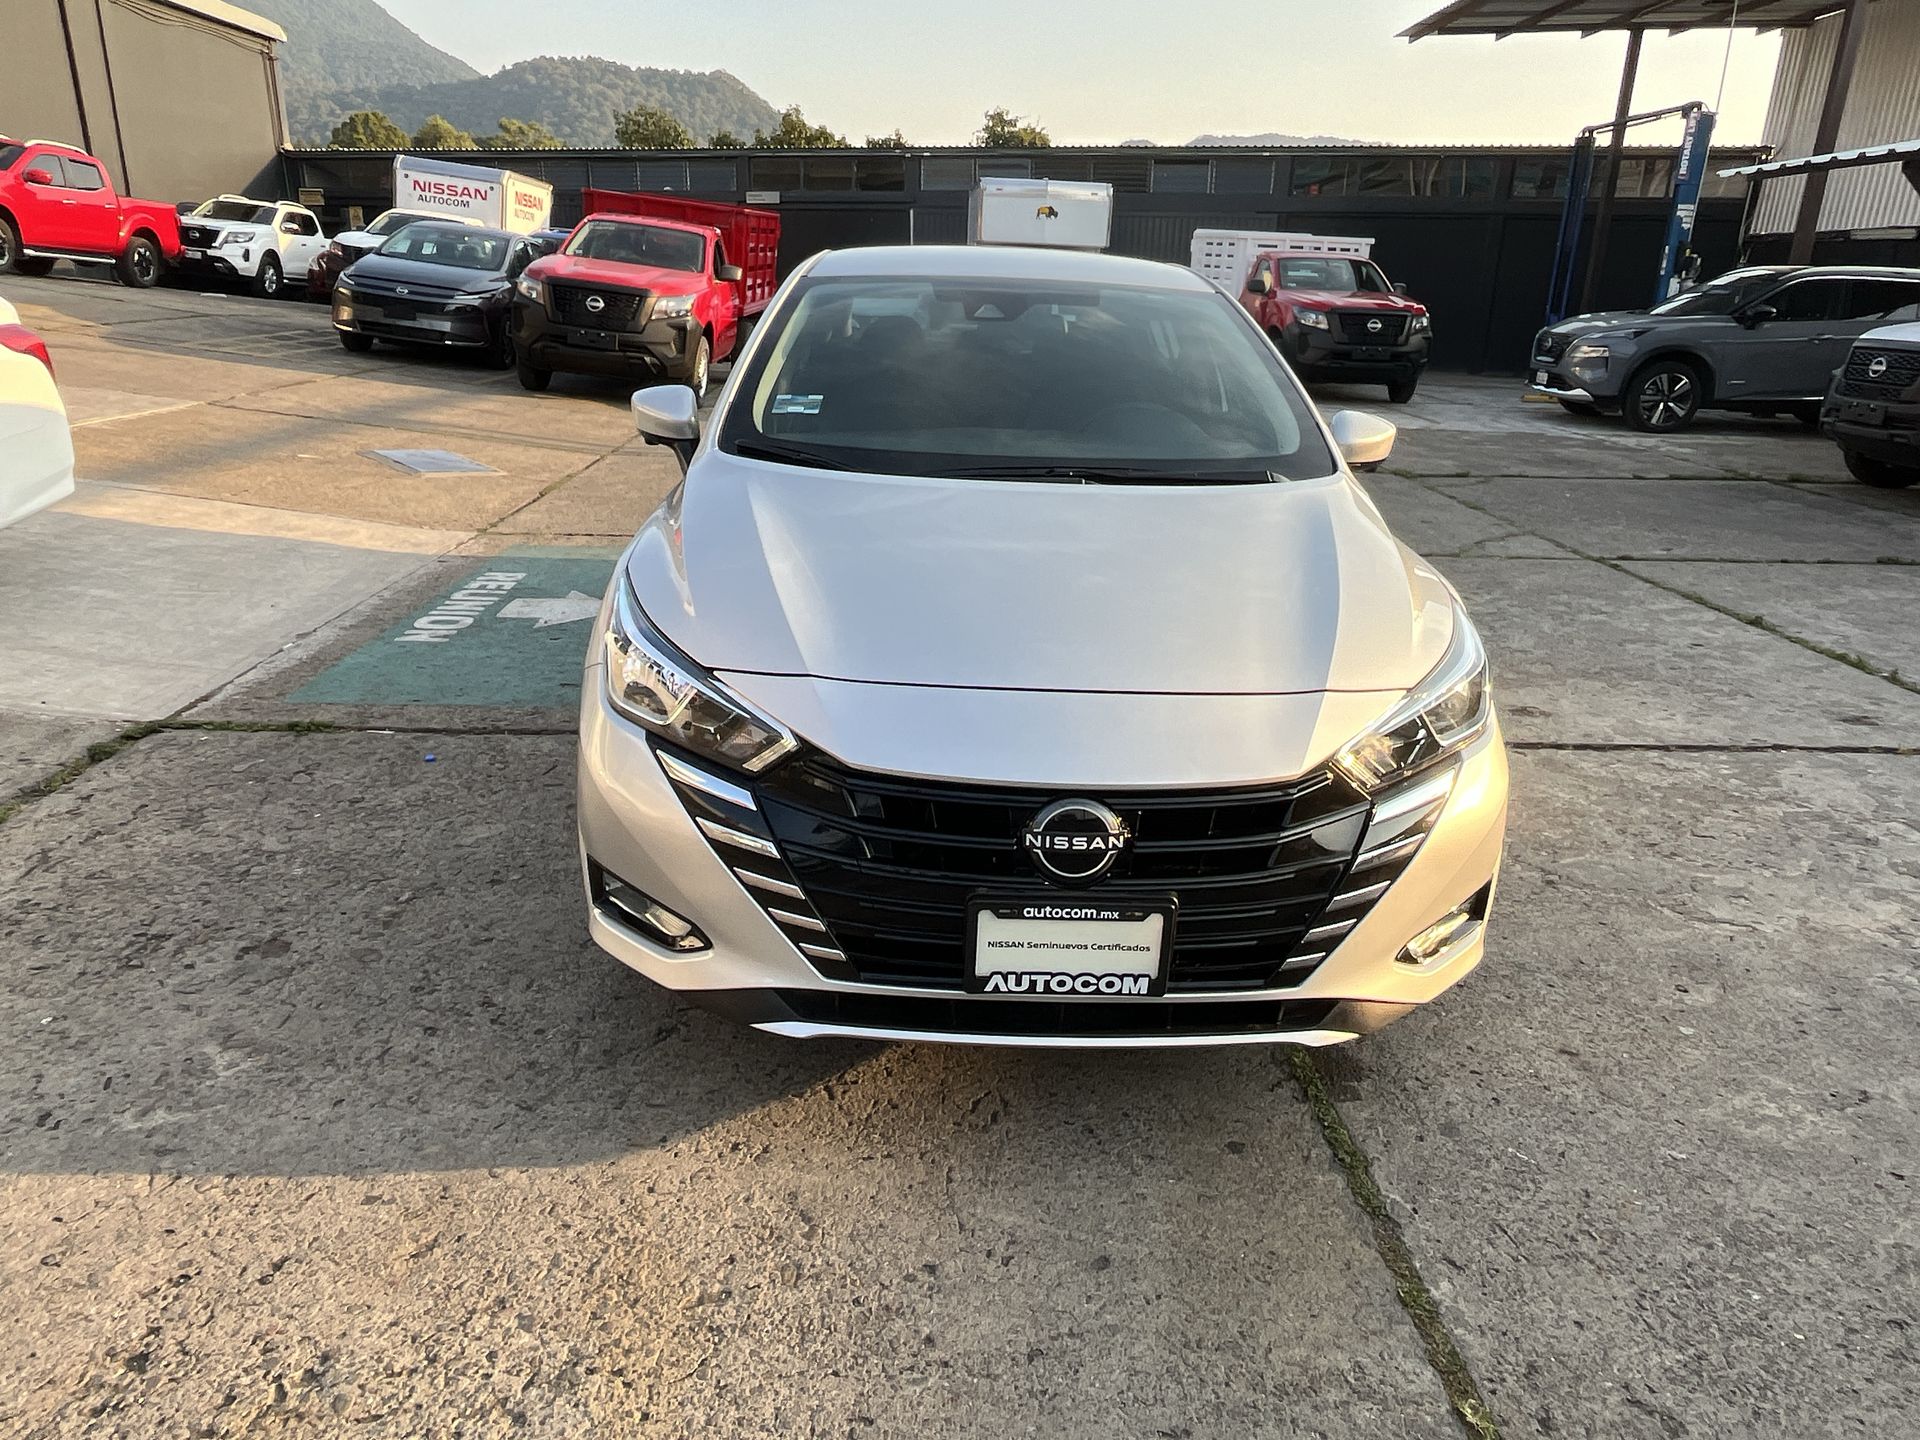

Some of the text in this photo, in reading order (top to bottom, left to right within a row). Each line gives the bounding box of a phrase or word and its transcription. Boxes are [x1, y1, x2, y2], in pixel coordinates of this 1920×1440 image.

[413, 179, 488, 201] NISSAN
[417, 194, 470, 209] AUTOCOM
[515, 190, 543, 211] NISSAN
[1025, 834, 1124, 850] NISSAN
[1023, 906, 1120, 920] autocom.mx
[987, 941, 1151, 952] NISSAN Seminuevos Certificados
[984, 974, 1149, 994] AUTOCOM
